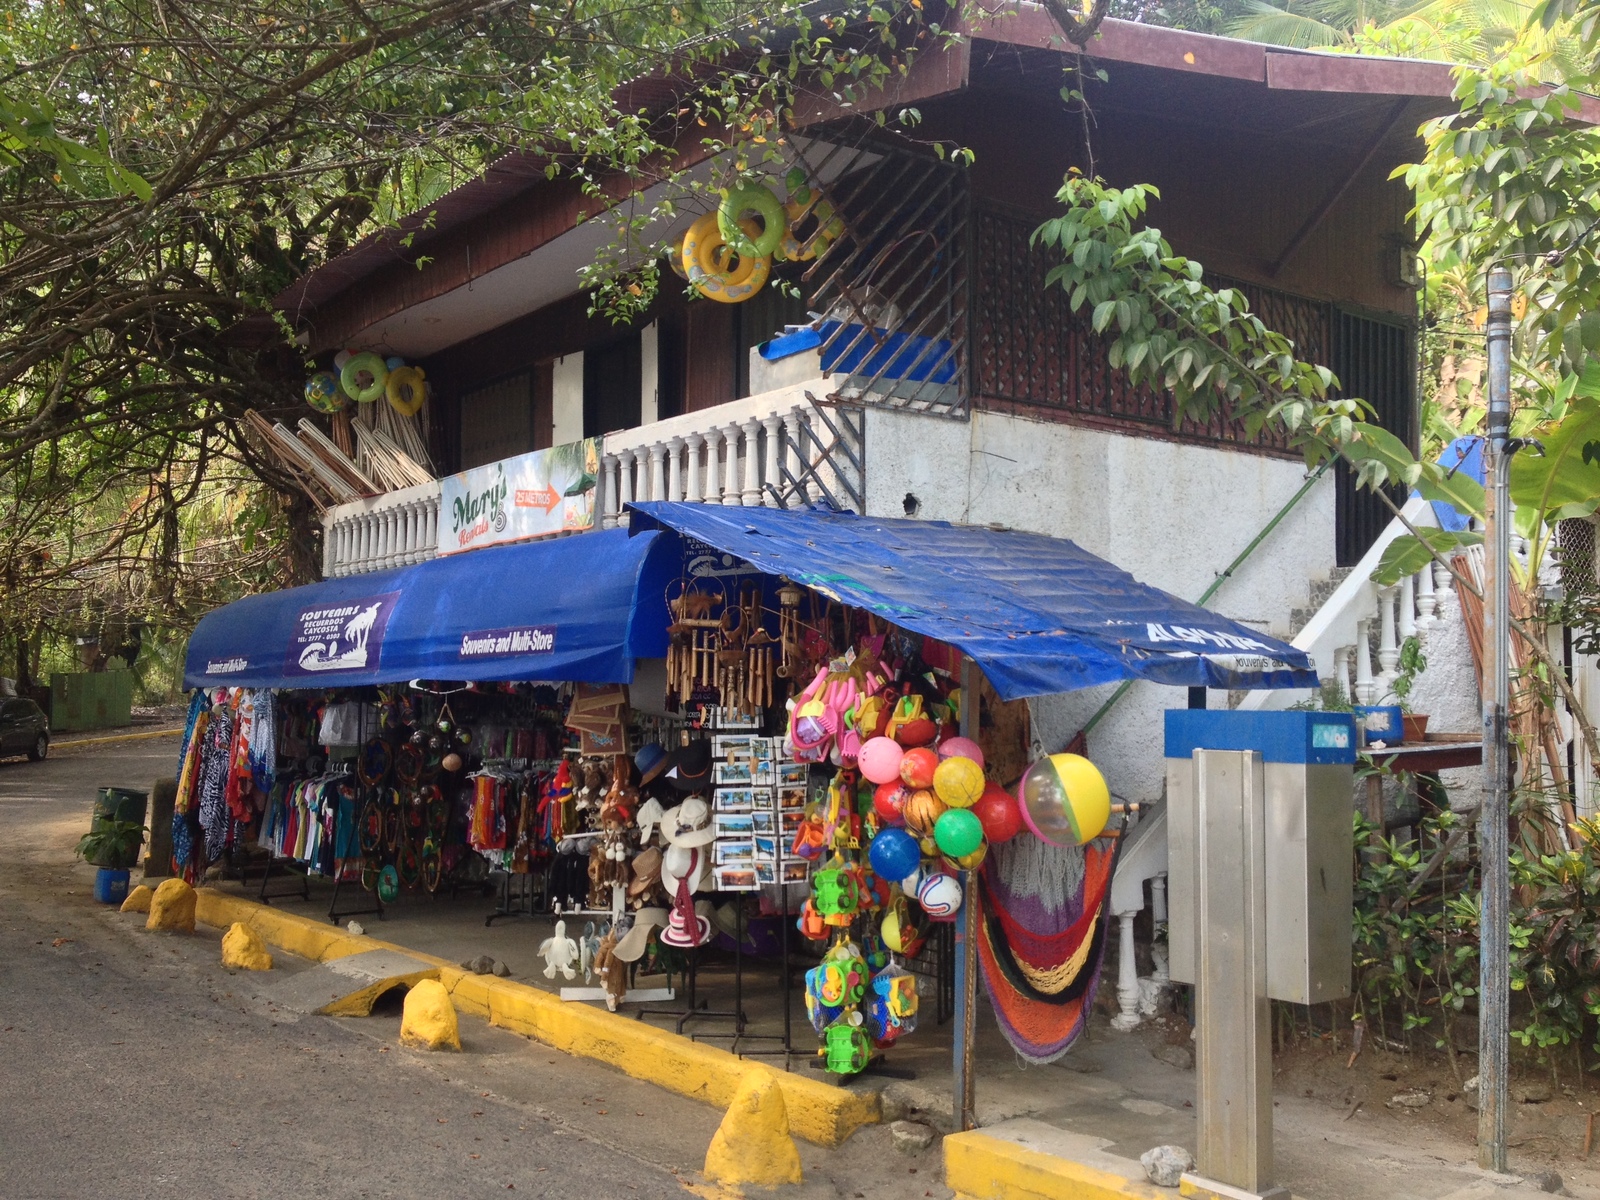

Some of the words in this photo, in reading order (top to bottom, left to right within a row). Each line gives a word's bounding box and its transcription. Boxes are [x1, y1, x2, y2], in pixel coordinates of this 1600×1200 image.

[452, 463, 507, 534] Mary's
[515, 491, 525, 504] 25
[525, 492, 551, 506] METROS
[458, 516, 489, 547] Rentals
[300, 605, 360, 621] SOUVENIRS
[303, 617, 344, 628] RECUERDOS
[303, 625, 338, 635] CAYCOSTA
[460, 634, 496, 655] Souvenirs
[495, 632, 513, 653] and
[510, 629, 553, 652] Multi-Store
